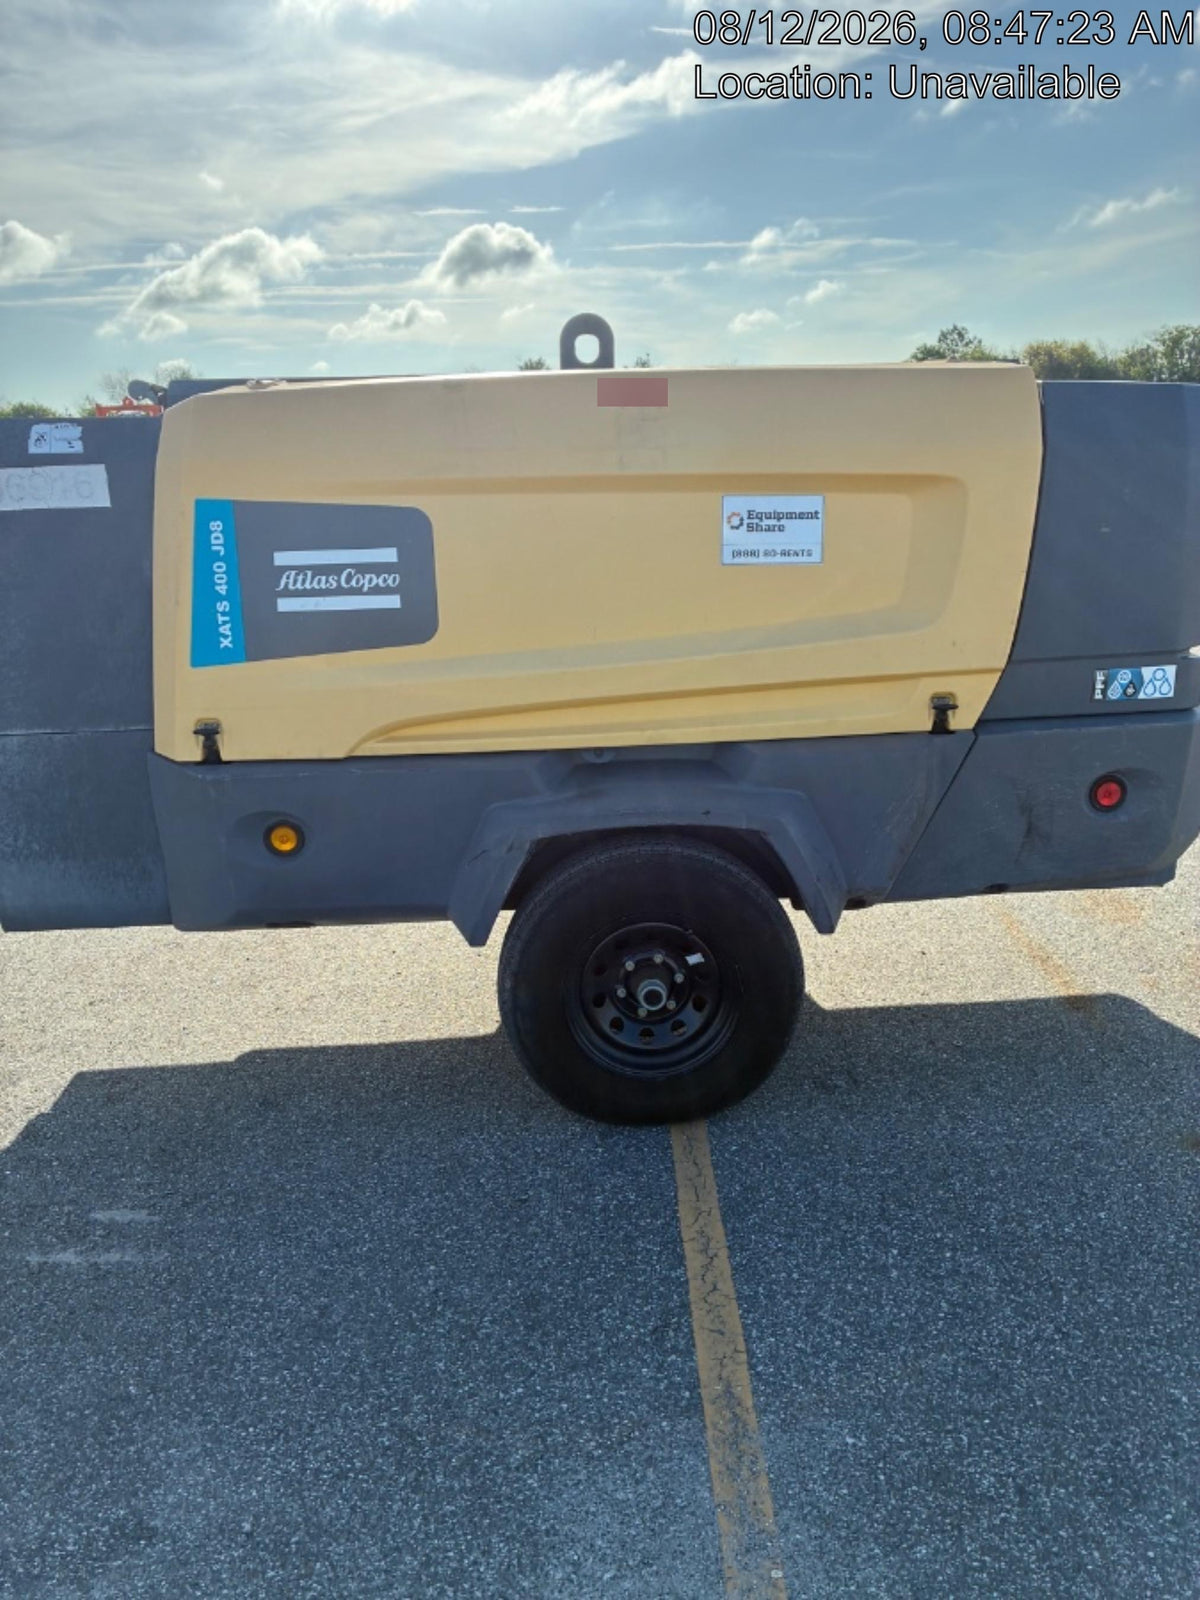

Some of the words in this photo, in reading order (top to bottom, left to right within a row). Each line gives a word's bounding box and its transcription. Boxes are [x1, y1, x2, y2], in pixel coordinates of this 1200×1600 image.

[746, 510, 820, 521] Equipment
[746, 522, 785, 532] Share
[209, 520, 225, 556] JD8
[213, 561, 228, 595] 400
[275, 570, 338, 590] Atlas
[340, 568, 400, 592] Copco
[216, 601, 233, 649] XATS
